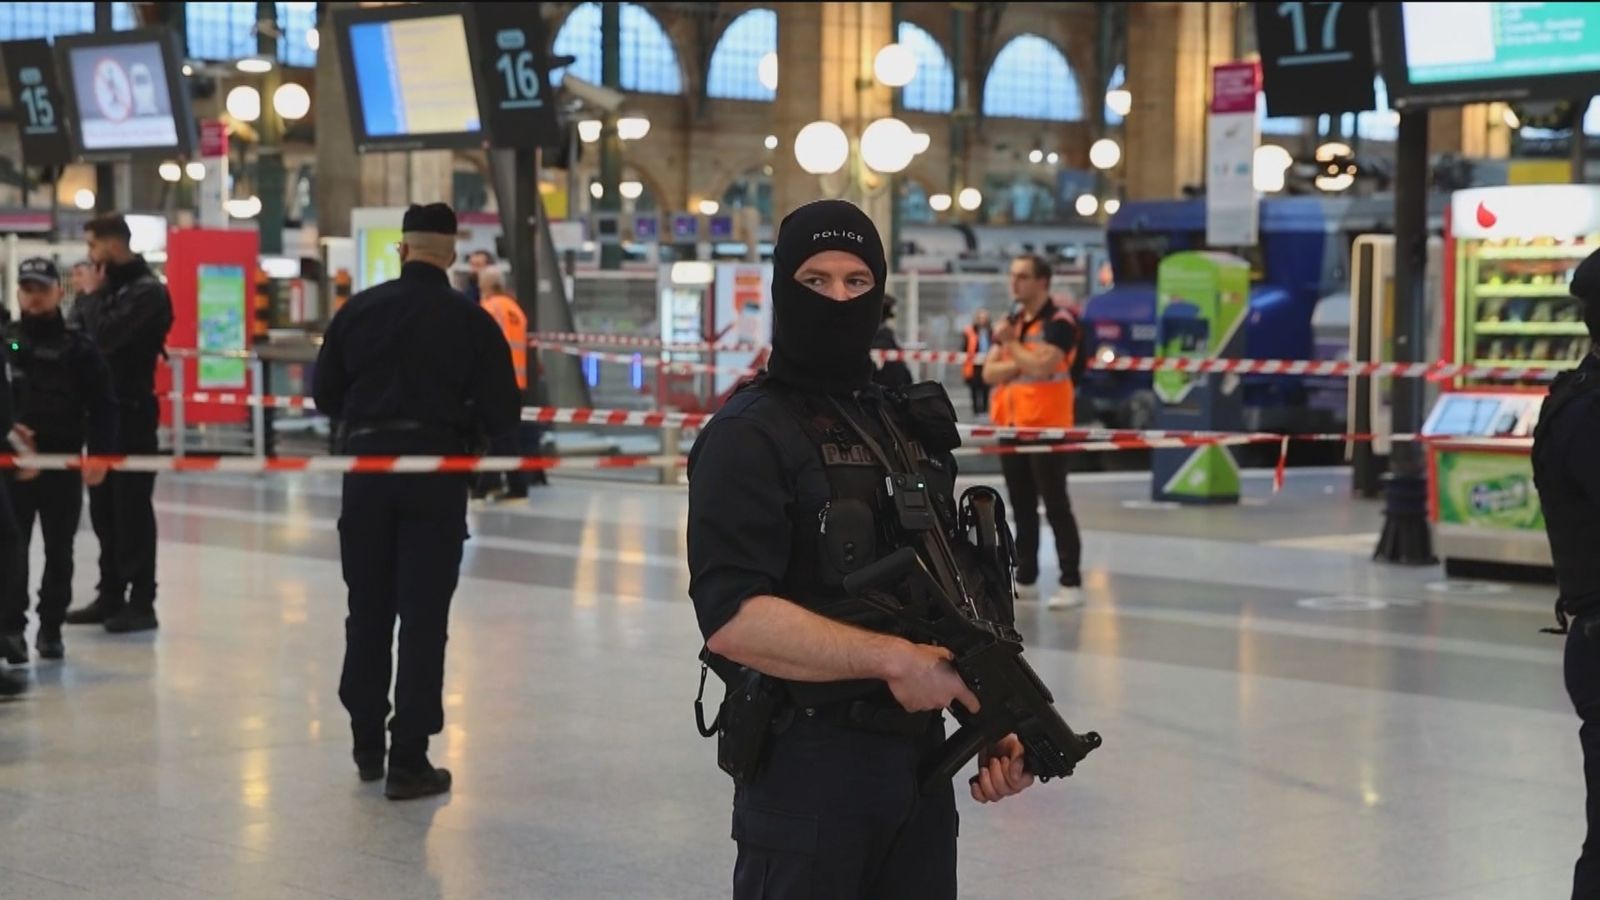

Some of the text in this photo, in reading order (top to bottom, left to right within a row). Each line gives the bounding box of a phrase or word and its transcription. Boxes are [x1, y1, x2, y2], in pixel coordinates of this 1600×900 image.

[1278, 2, 1343, 52] 17
[497, 51, 540, 99] 16
[21, 86, 54, 126] 15
[813, 229, 864, 244] POLICE
